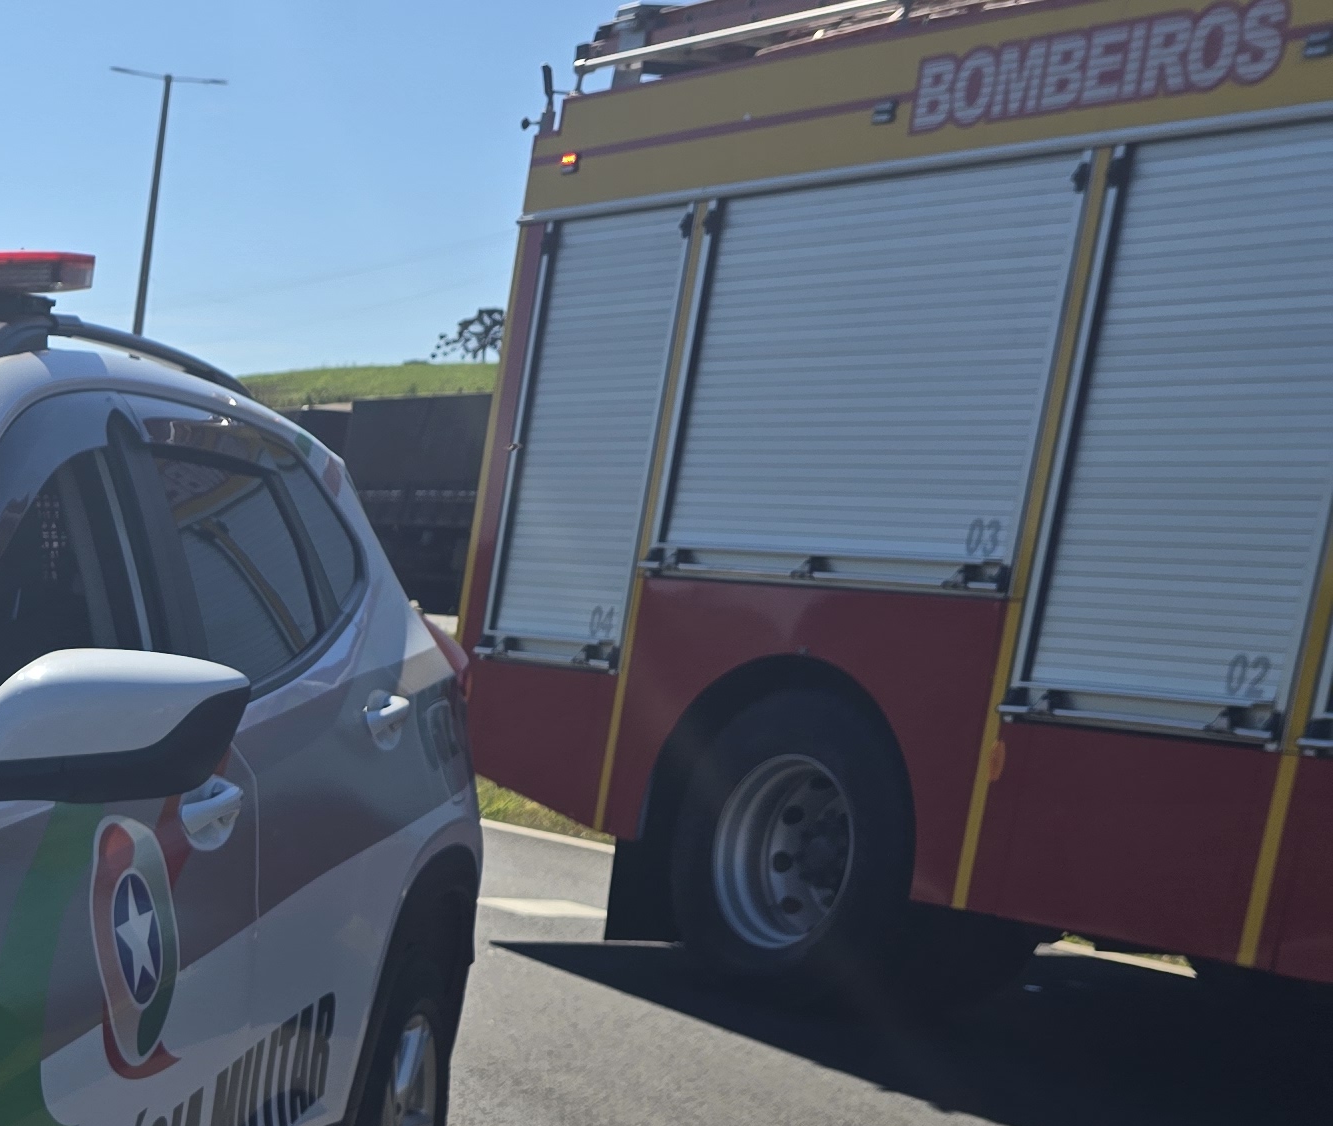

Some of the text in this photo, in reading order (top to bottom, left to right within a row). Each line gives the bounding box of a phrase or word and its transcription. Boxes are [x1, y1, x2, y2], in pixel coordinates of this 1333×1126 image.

[913, 4, 1286, 131] BOMBEIROS
[964, 518, 1002, 557] 03
[588, 606, 616, 639] 04
[1225, 653, 1274, 698] 02
